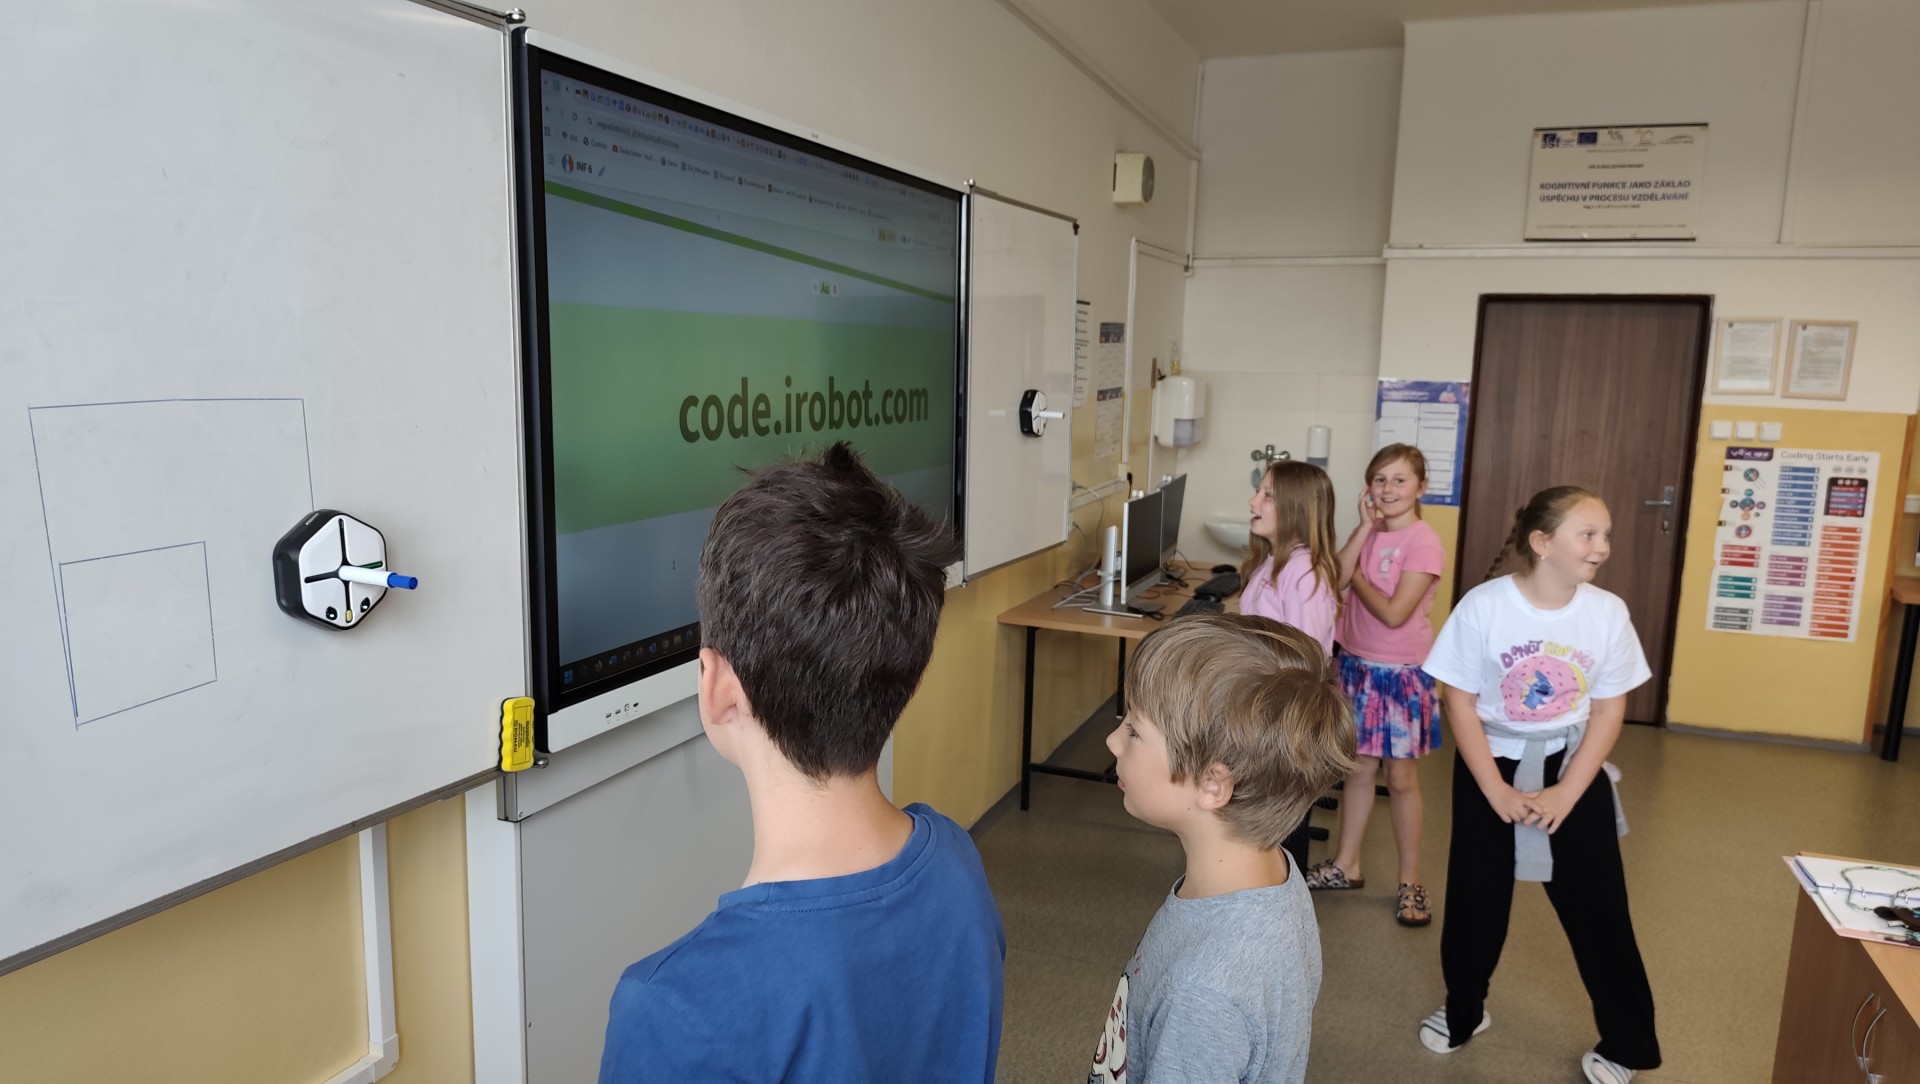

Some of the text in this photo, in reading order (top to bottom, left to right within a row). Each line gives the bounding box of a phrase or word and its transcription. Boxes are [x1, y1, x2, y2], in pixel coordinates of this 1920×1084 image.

[576, 161, 593, 174] INF 6
[1539, 179, 1691, 190] KOGNITIVNÍ FUNKCE JAKO ZÁKLAD
[1539, 191, 1688, 203] ÚSPĚCHU V PROCESU VZDĚLÁVÁNÍ
[678, 375, 929, 444] code.irobot.com
[1780, 451, 1869, 463] Coding Starts Early
